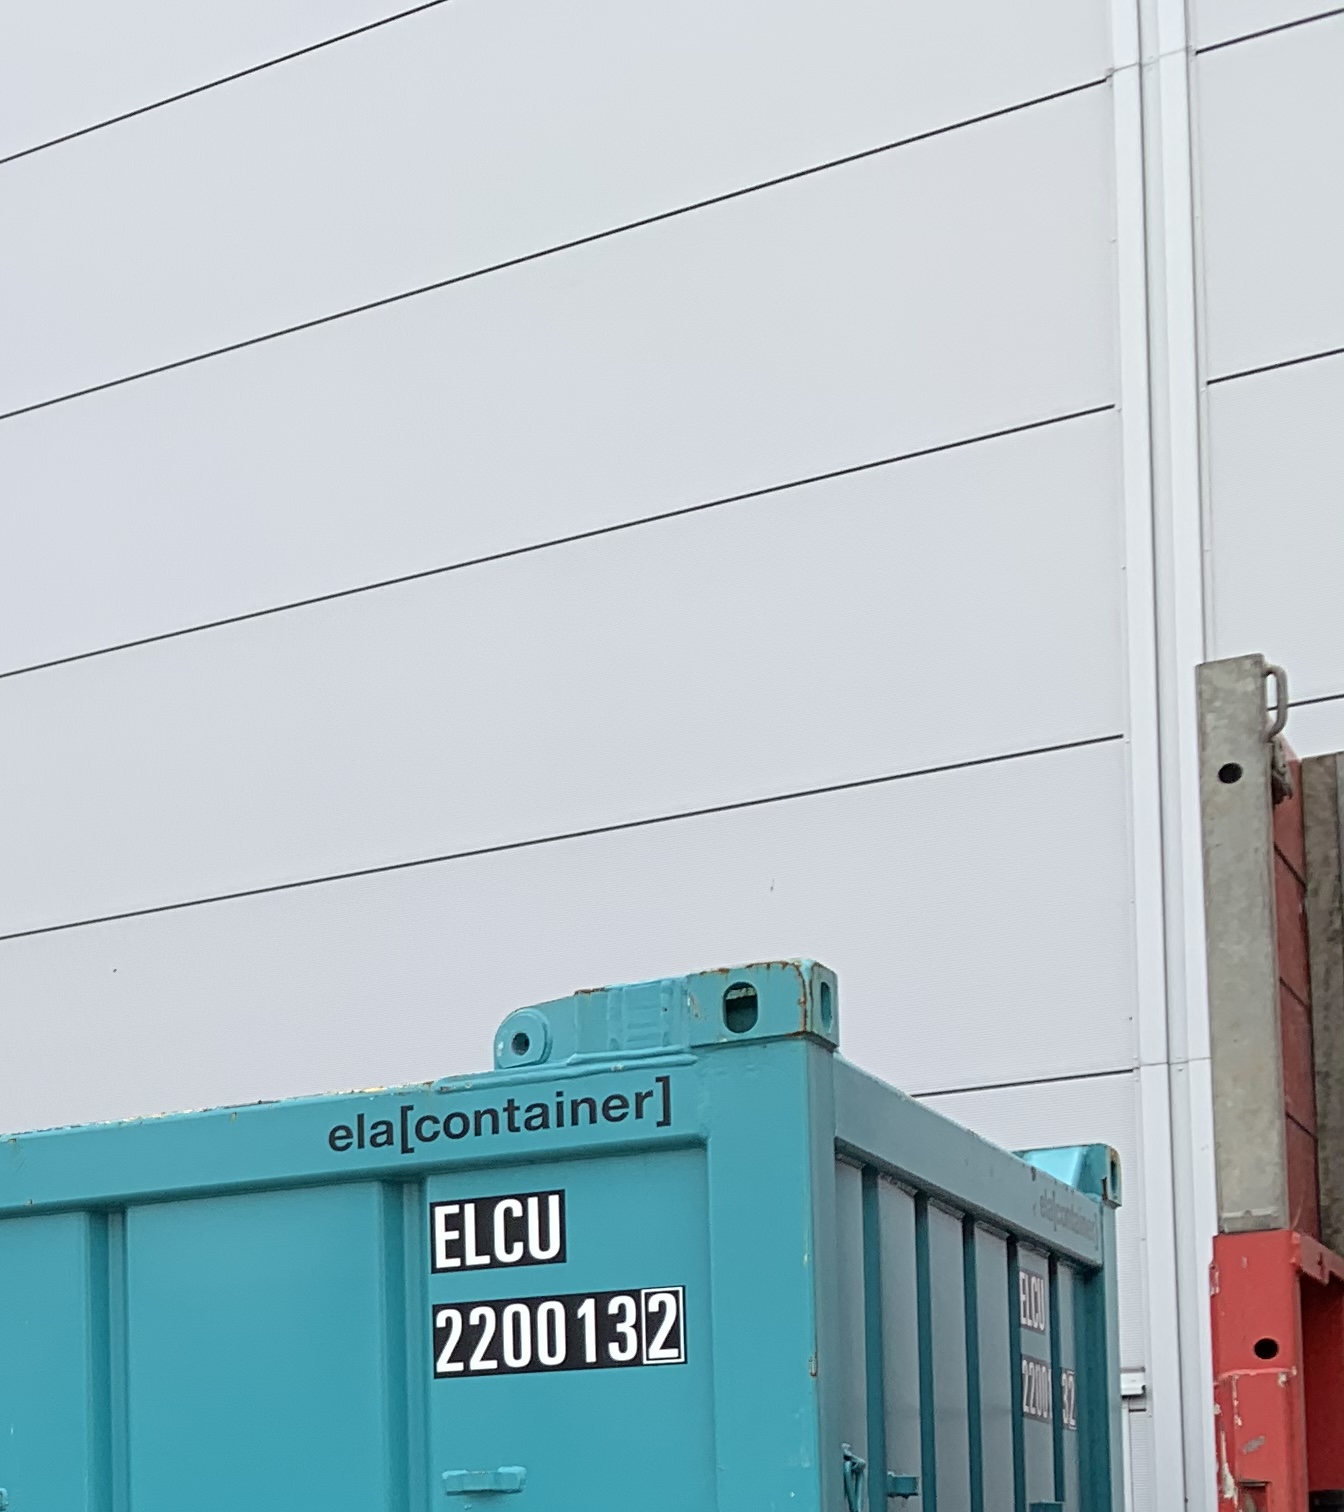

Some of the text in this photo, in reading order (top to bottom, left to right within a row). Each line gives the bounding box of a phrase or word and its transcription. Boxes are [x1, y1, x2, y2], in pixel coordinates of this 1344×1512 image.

[328, 1075, 672, 1154] ela[container]
[434, 1194, 561, 1269] ELCU
[435, 1289, 682, 1374] 2200132
[1019, 1271, 1045, 1331] ELCU
